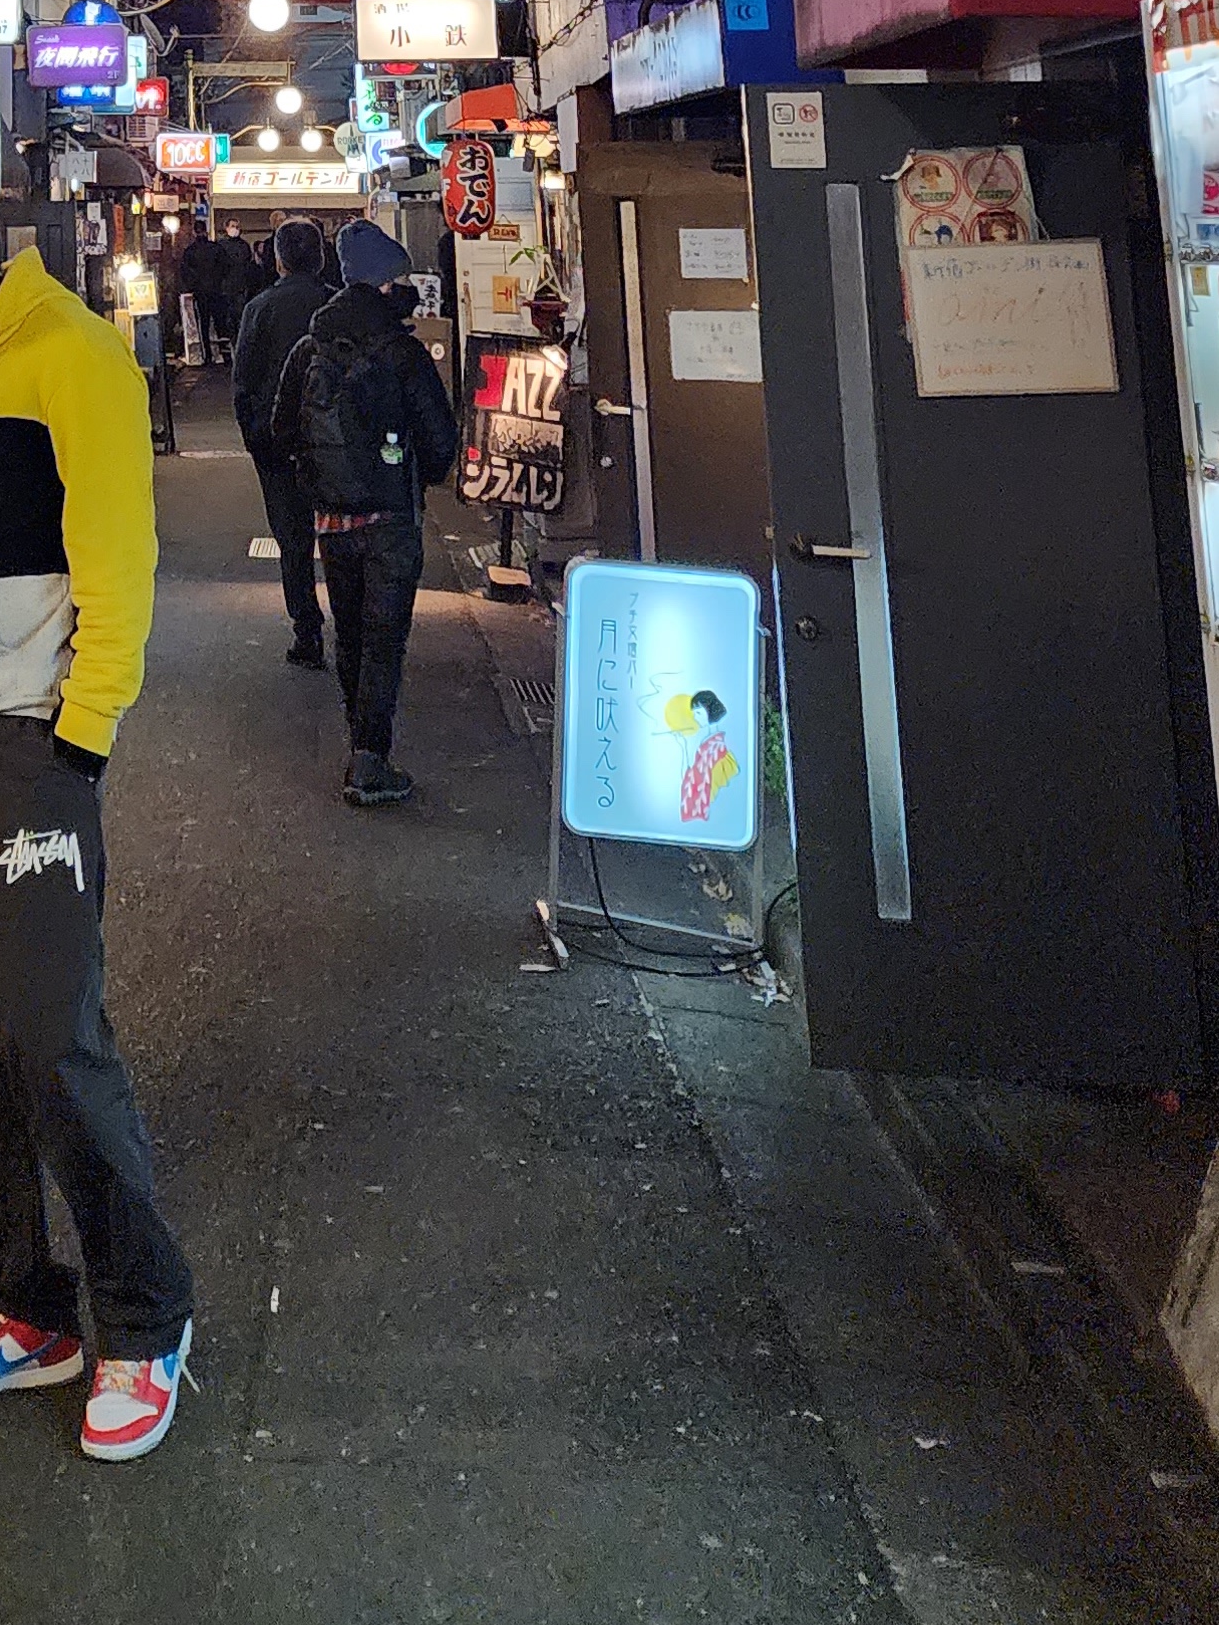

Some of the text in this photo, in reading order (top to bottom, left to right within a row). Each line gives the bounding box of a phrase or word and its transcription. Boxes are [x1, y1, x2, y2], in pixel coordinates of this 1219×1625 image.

[33, 45, 120, 69] 夜間飛行
[456, 145, 492, 227] おでん
[474, 354, 563, 422] JAZZ
[595, 618, 620, 809] 月に吠える
